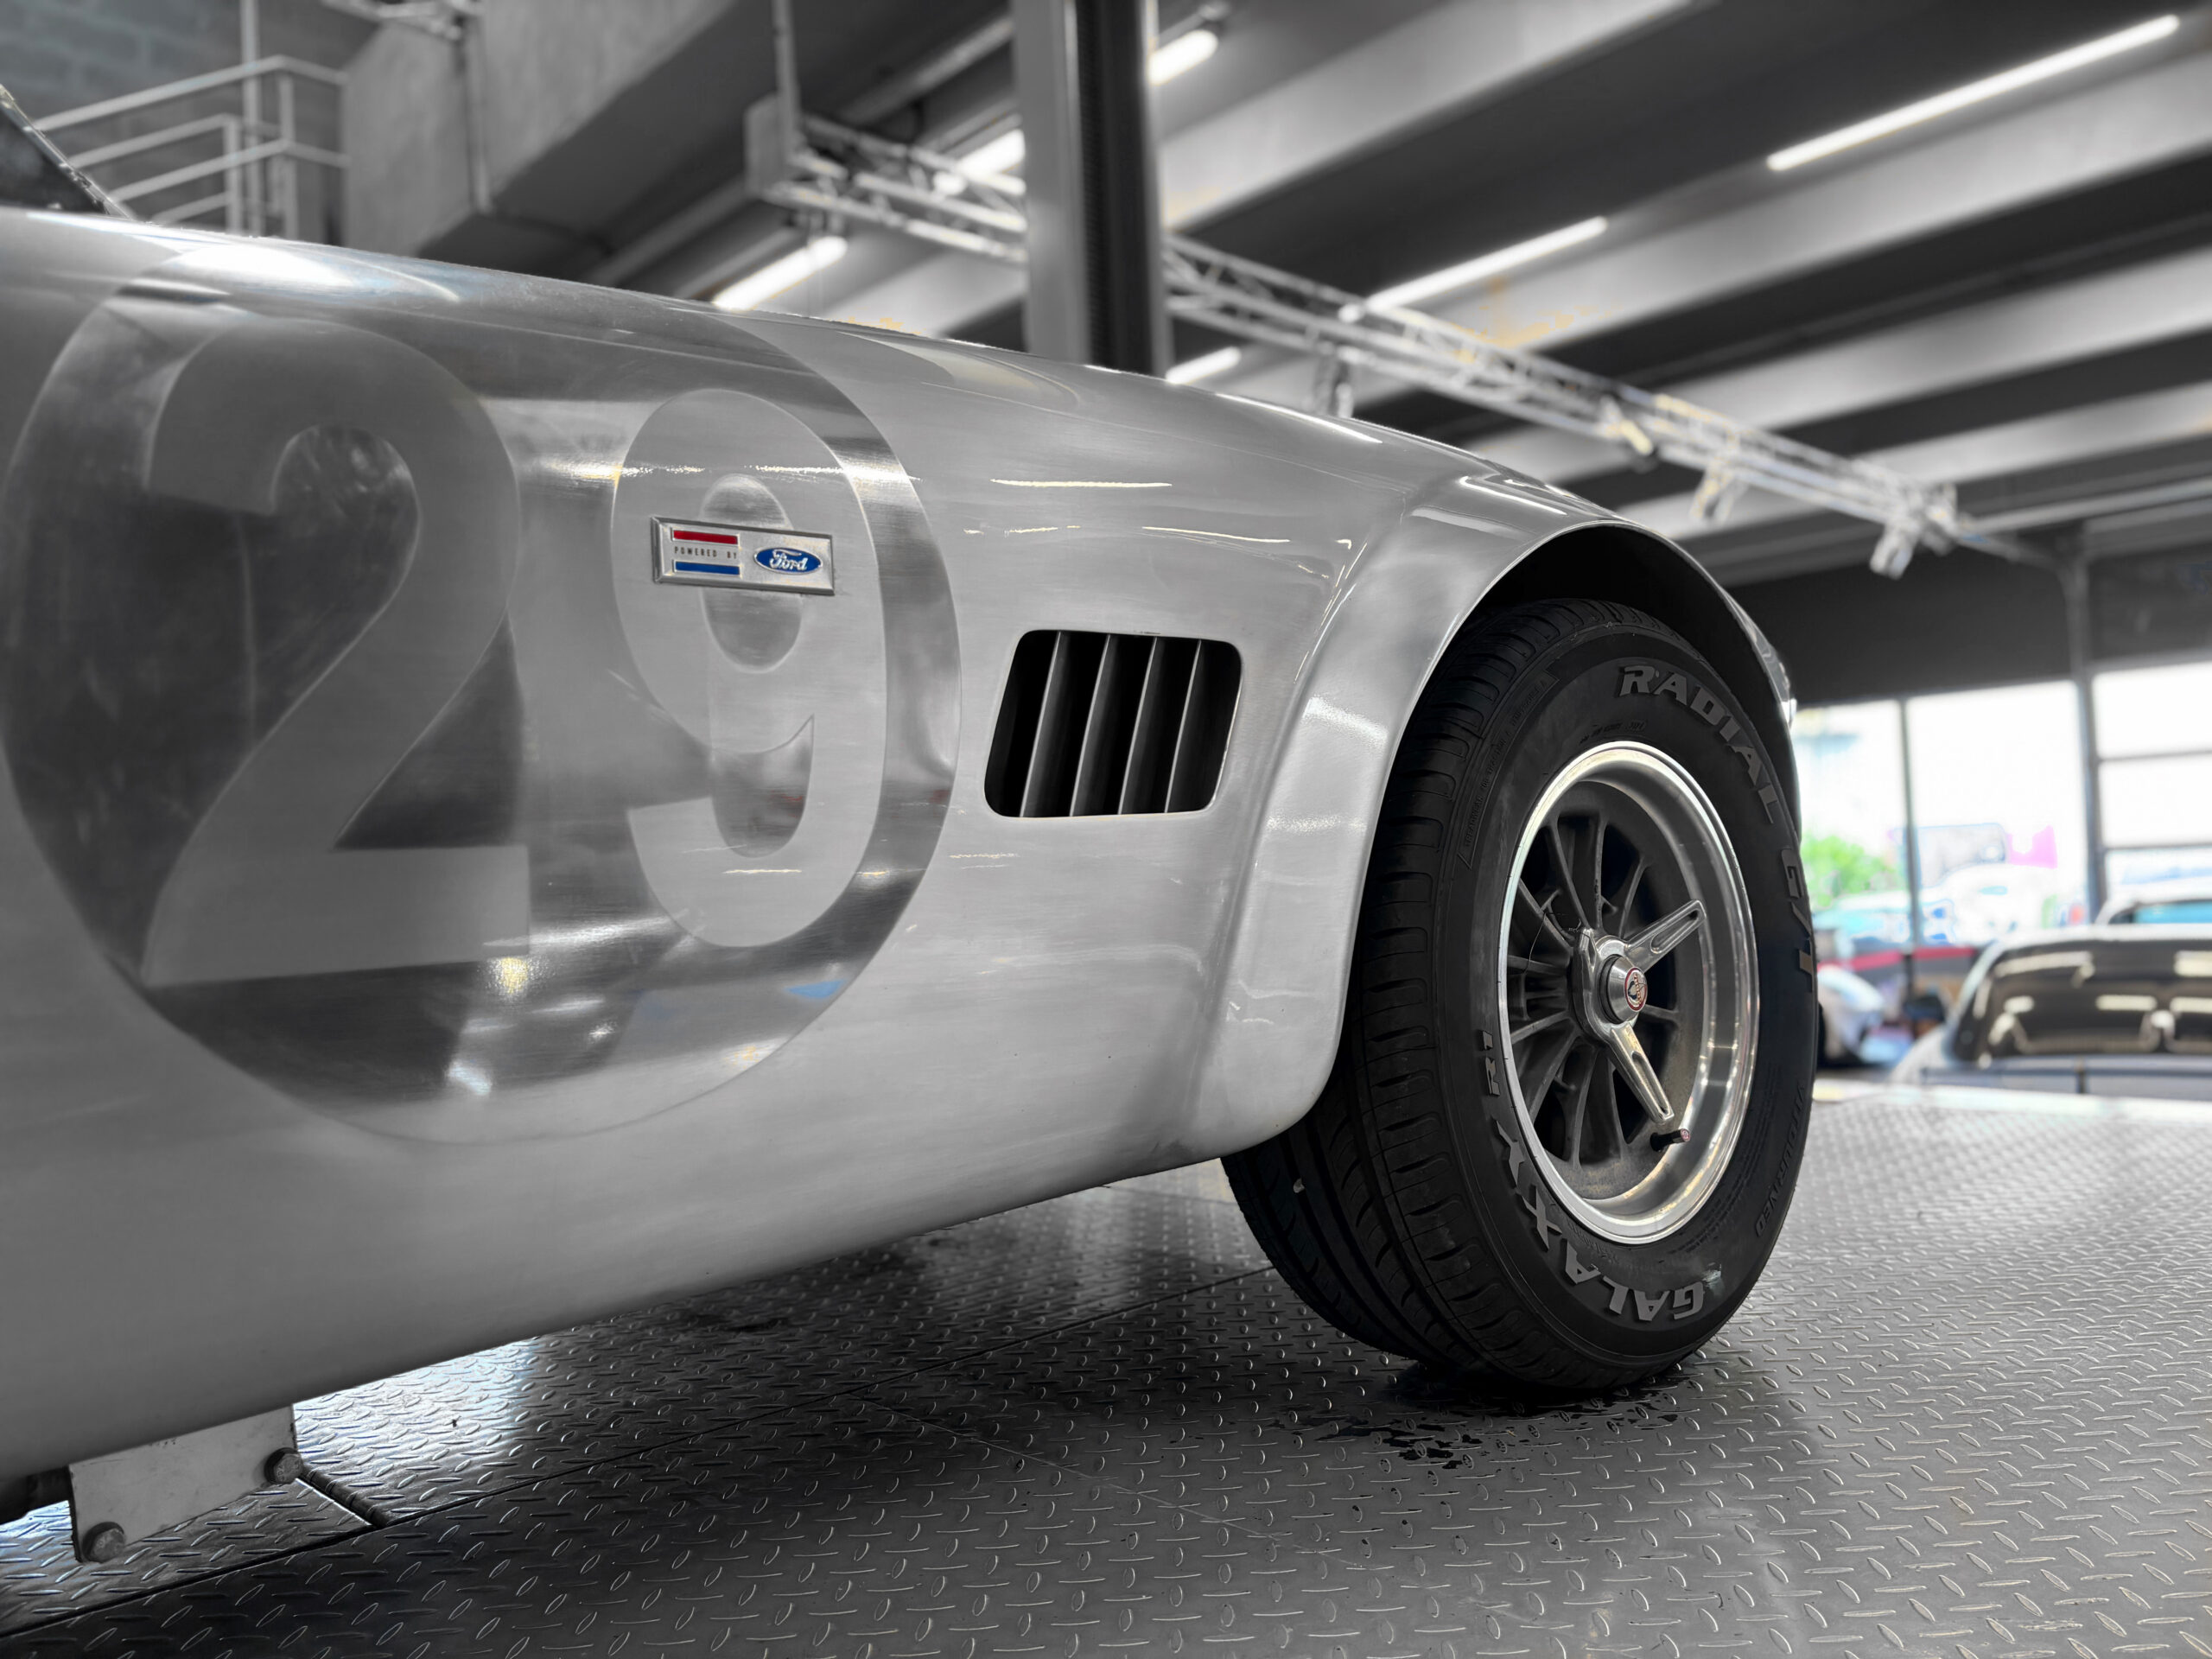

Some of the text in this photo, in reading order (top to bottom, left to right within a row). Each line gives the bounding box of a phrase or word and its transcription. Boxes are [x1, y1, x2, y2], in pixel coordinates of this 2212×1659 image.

[674, 545, 737, 560] POWERED BY
[769, 548, 809, 571] Ford
[141, 320, 888, 988] 29
[1619, 664, 1780, 825] RADIAL
[1496, 1119, 1705, 1322] GALAXY
